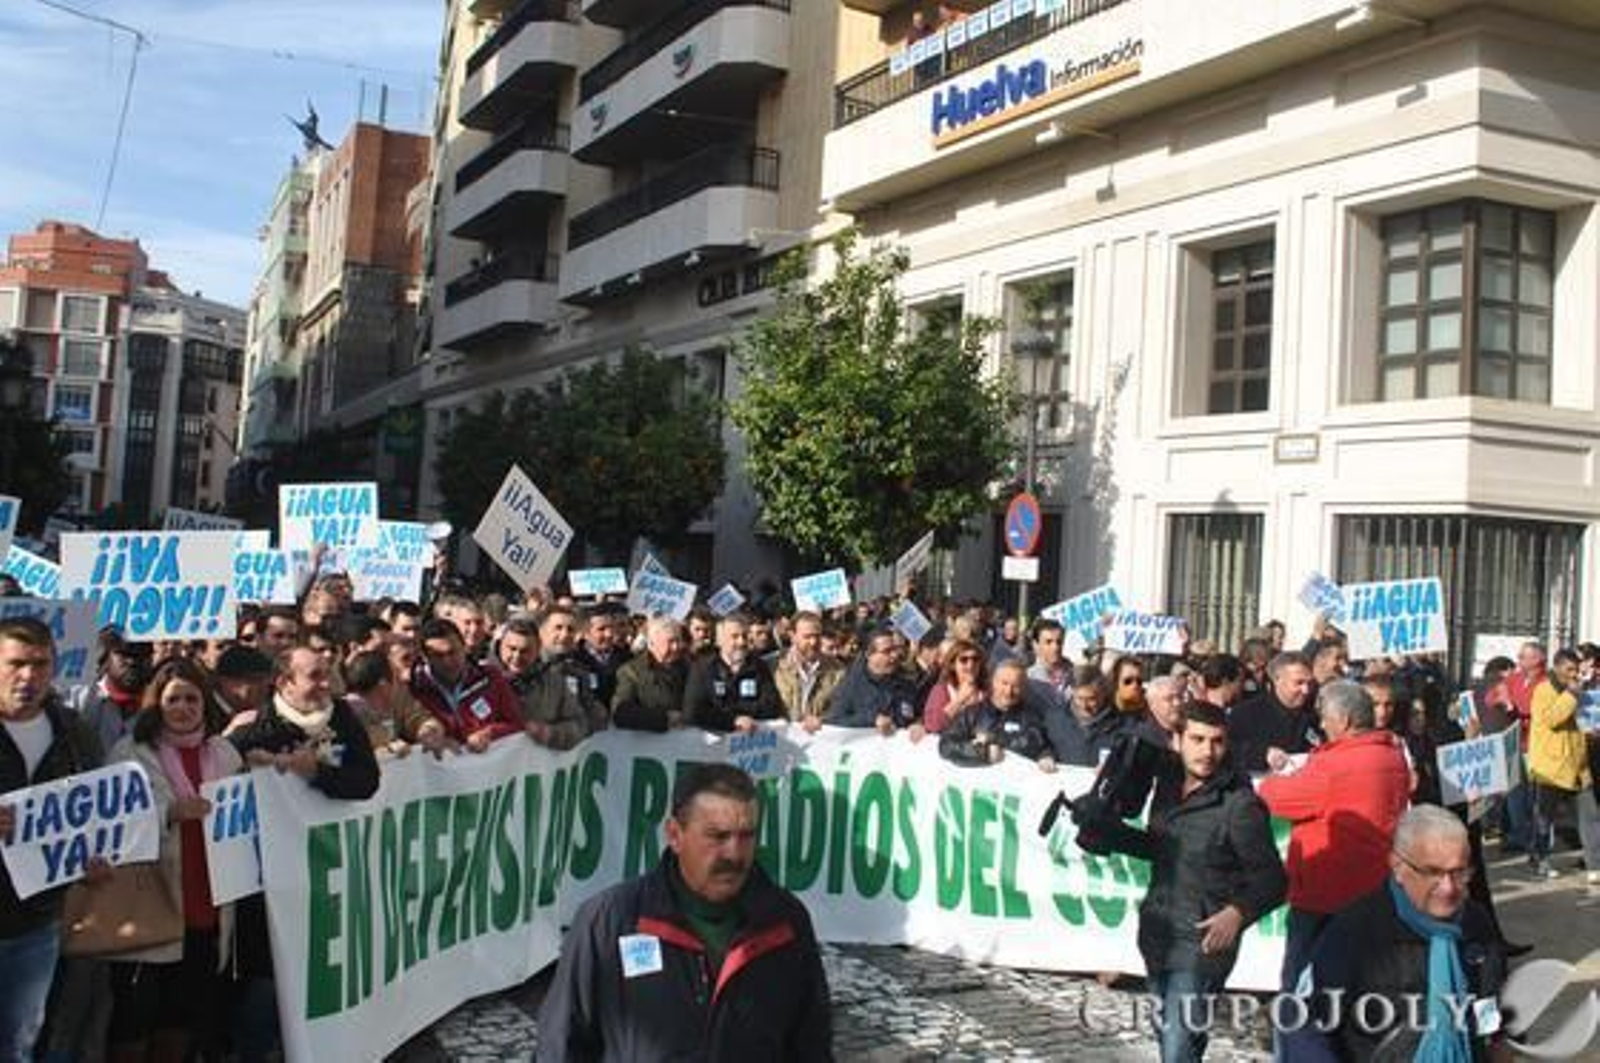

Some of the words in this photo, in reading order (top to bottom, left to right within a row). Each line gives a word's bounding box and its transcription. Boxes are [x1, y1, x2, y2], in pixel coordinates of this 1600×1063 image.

[932, 59, 1047, 136] Huelva
[1050, 39, 1144, 88] Información
[286, 487, 371, 517] ¡¡AGUA
[312, 518, 360, 545] YA!!
[234, 552, 287, 576] GUA
[1352, 581, 1439, 621] ¡¡AGUA
[1379, 616, 1429, 654] YA!!
[42, 822, 124, 883] YA!!
[305, 814, 374, 1021] EN
[624, 752, 922, 902] RADÍOS
